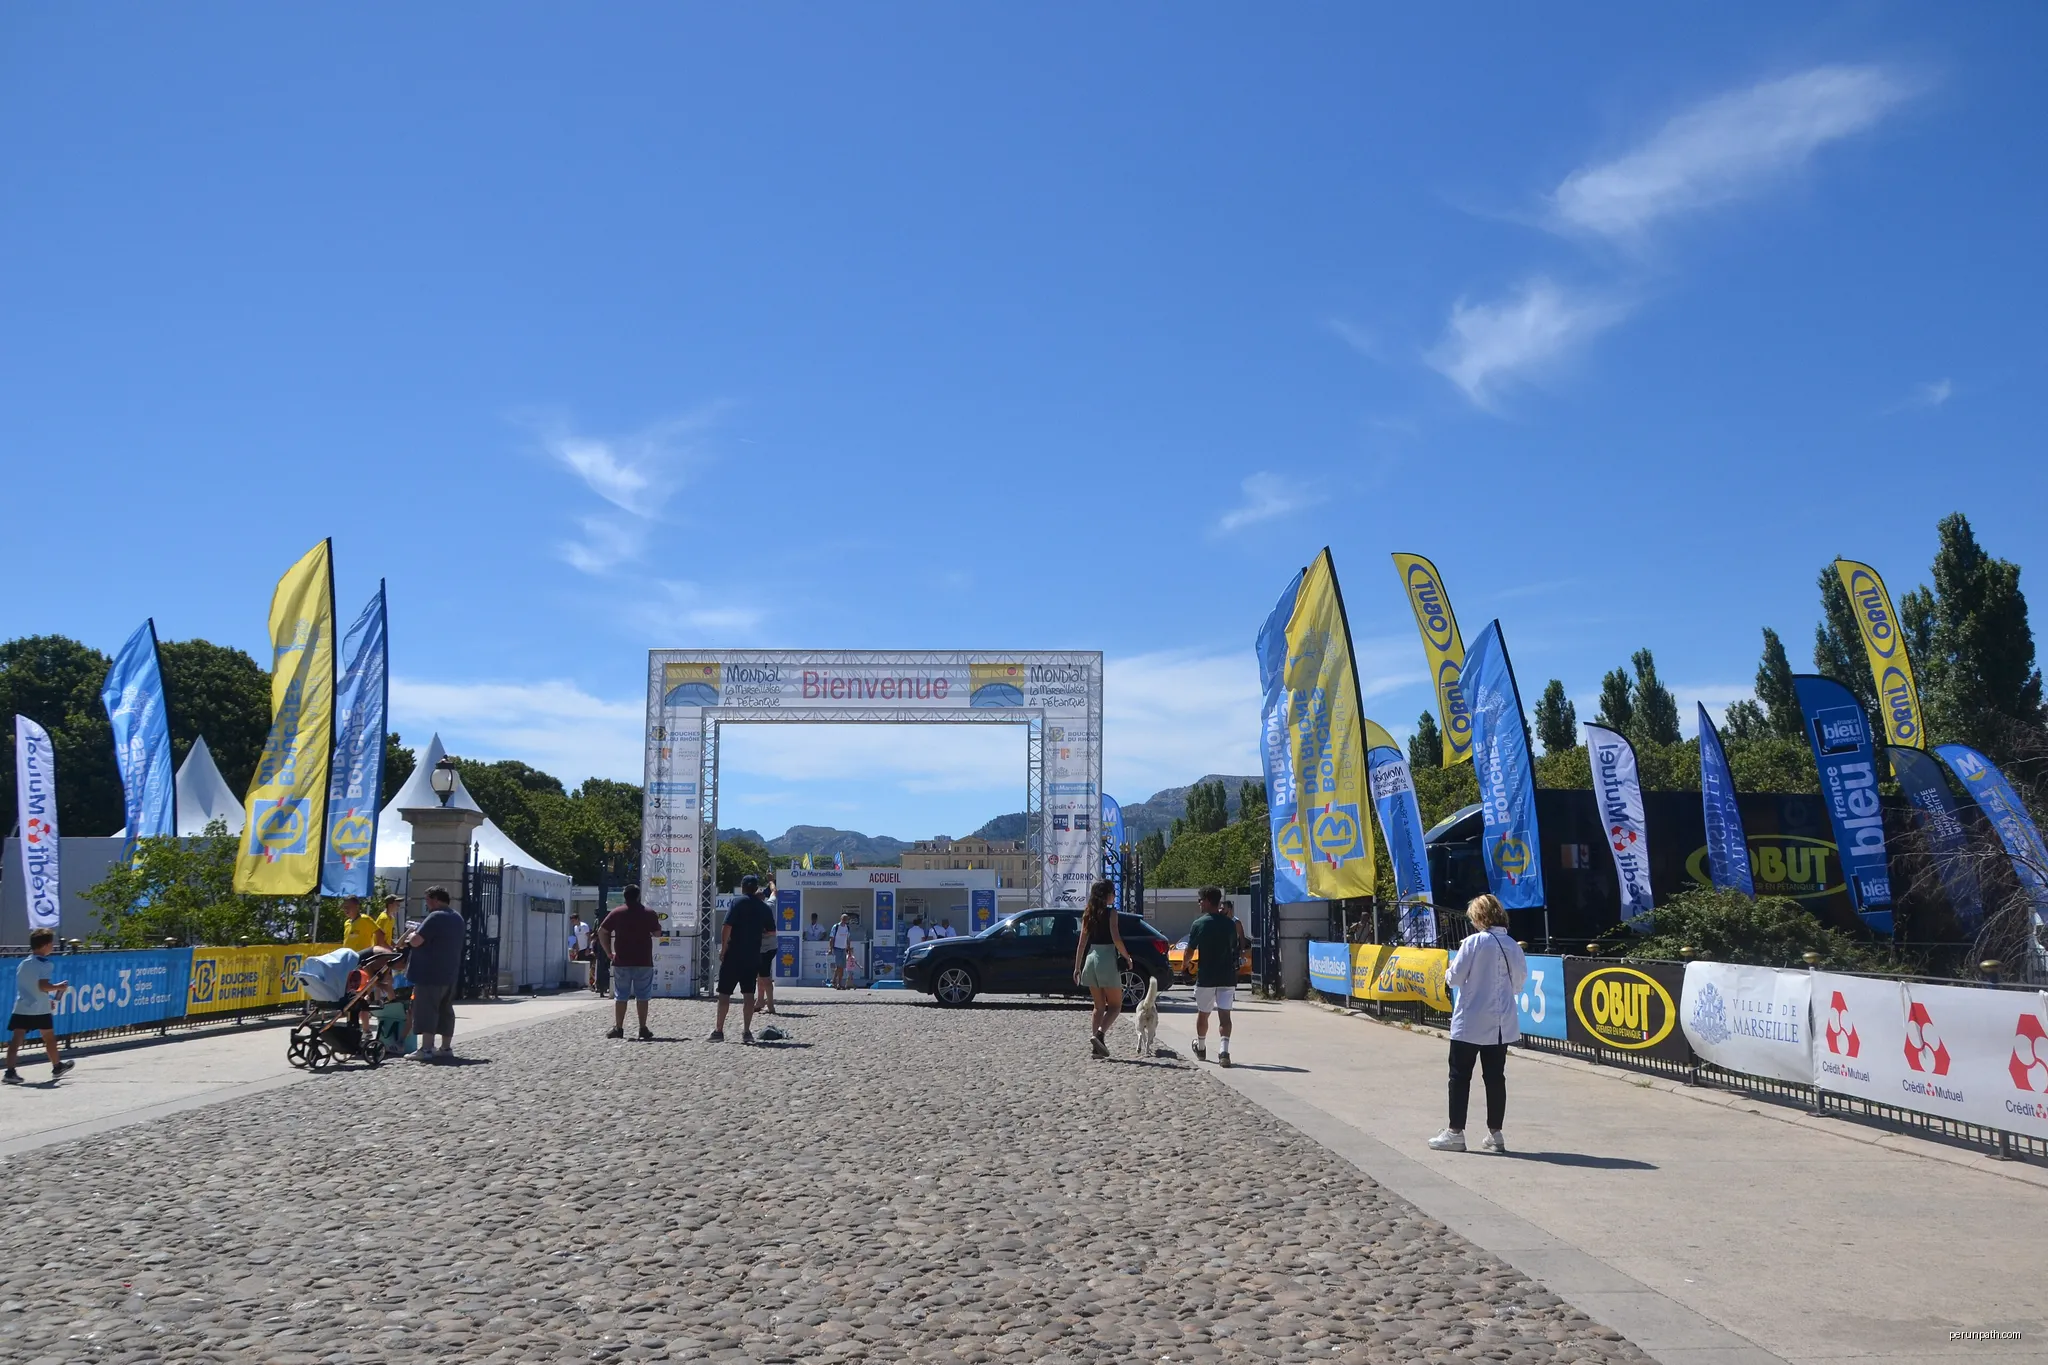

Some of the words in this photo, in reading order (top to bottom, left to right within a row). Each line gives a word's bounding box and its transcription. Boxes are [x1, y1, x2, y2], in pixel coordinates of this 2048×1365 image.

[802, 671, 948, 699] Bienvenue
[1823, 722, 1861, 740] bleu
[1832, 736, 1862, 745] provence
[1827, 766, 1847, 819] france
[1103, 808, 1117, 821] M
[1841, 762, 1886, 857] bleu
[1750, 847, 1829, 882] BUT
[869, 873, 901, 883] ACCUEIL
[135, 966, 166, 977] provence
[220, 971, 258, 986] BOUCHES
[135, 981, 152, 994] alpes
[134, 994, 149, 1006] côte
[150, 992, 172, 1004] d'azur
[1591, 979, 1651, 1031] OBUT
[1733, 998, 1773, 1015] VILLE
[1782, 1004, 1797, 1017] DE
[1596, 1024, 1613, 1035] PREMIER
[1613, 1026, 1620, 1036] EN
[1733, 1016, 1799, 1043] MARSEILLE
[1822, 1060, 1841, 1075] Crédit
[1848, 1069, 1870, 1082] Mutuel
[1902, 1079, 1926, 1095] Crédit
[1935, 1085, 1964, 1102] Mutuel
[2005, 1099, 2035, 1117] Crédit
